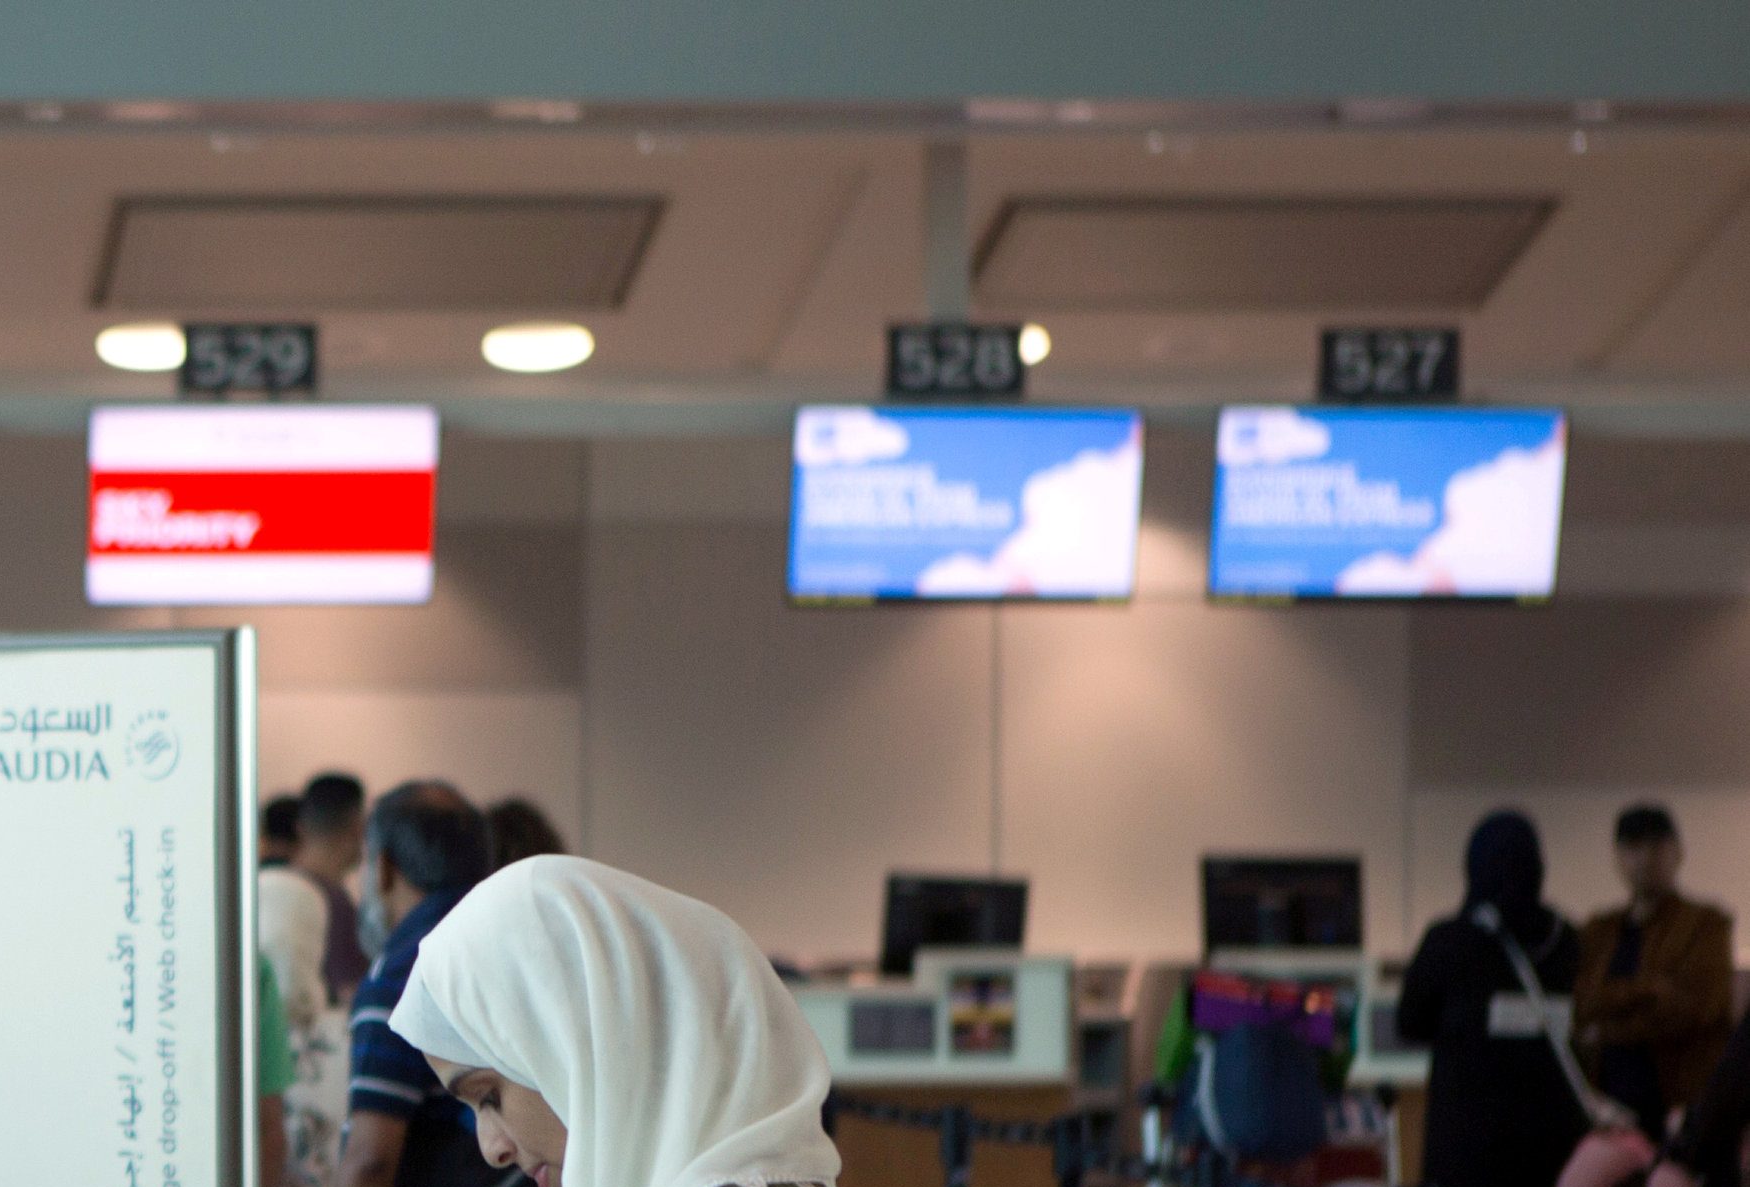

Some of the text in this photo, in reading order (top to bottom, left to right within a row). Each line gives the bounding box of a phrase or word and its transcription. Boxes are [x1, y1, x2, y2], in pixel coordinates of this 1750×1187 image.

[188, 335, 310, 391] 529
[897, 336, 1018, 393] 528
[1331, 336, 1446, 393] 527
[116, 827, 141, 924] تسليم
[156, 826, 177, 941] check-in
[157, 949, 177, 1015] Web
[156, 1037, 180, 1155] drop-off
